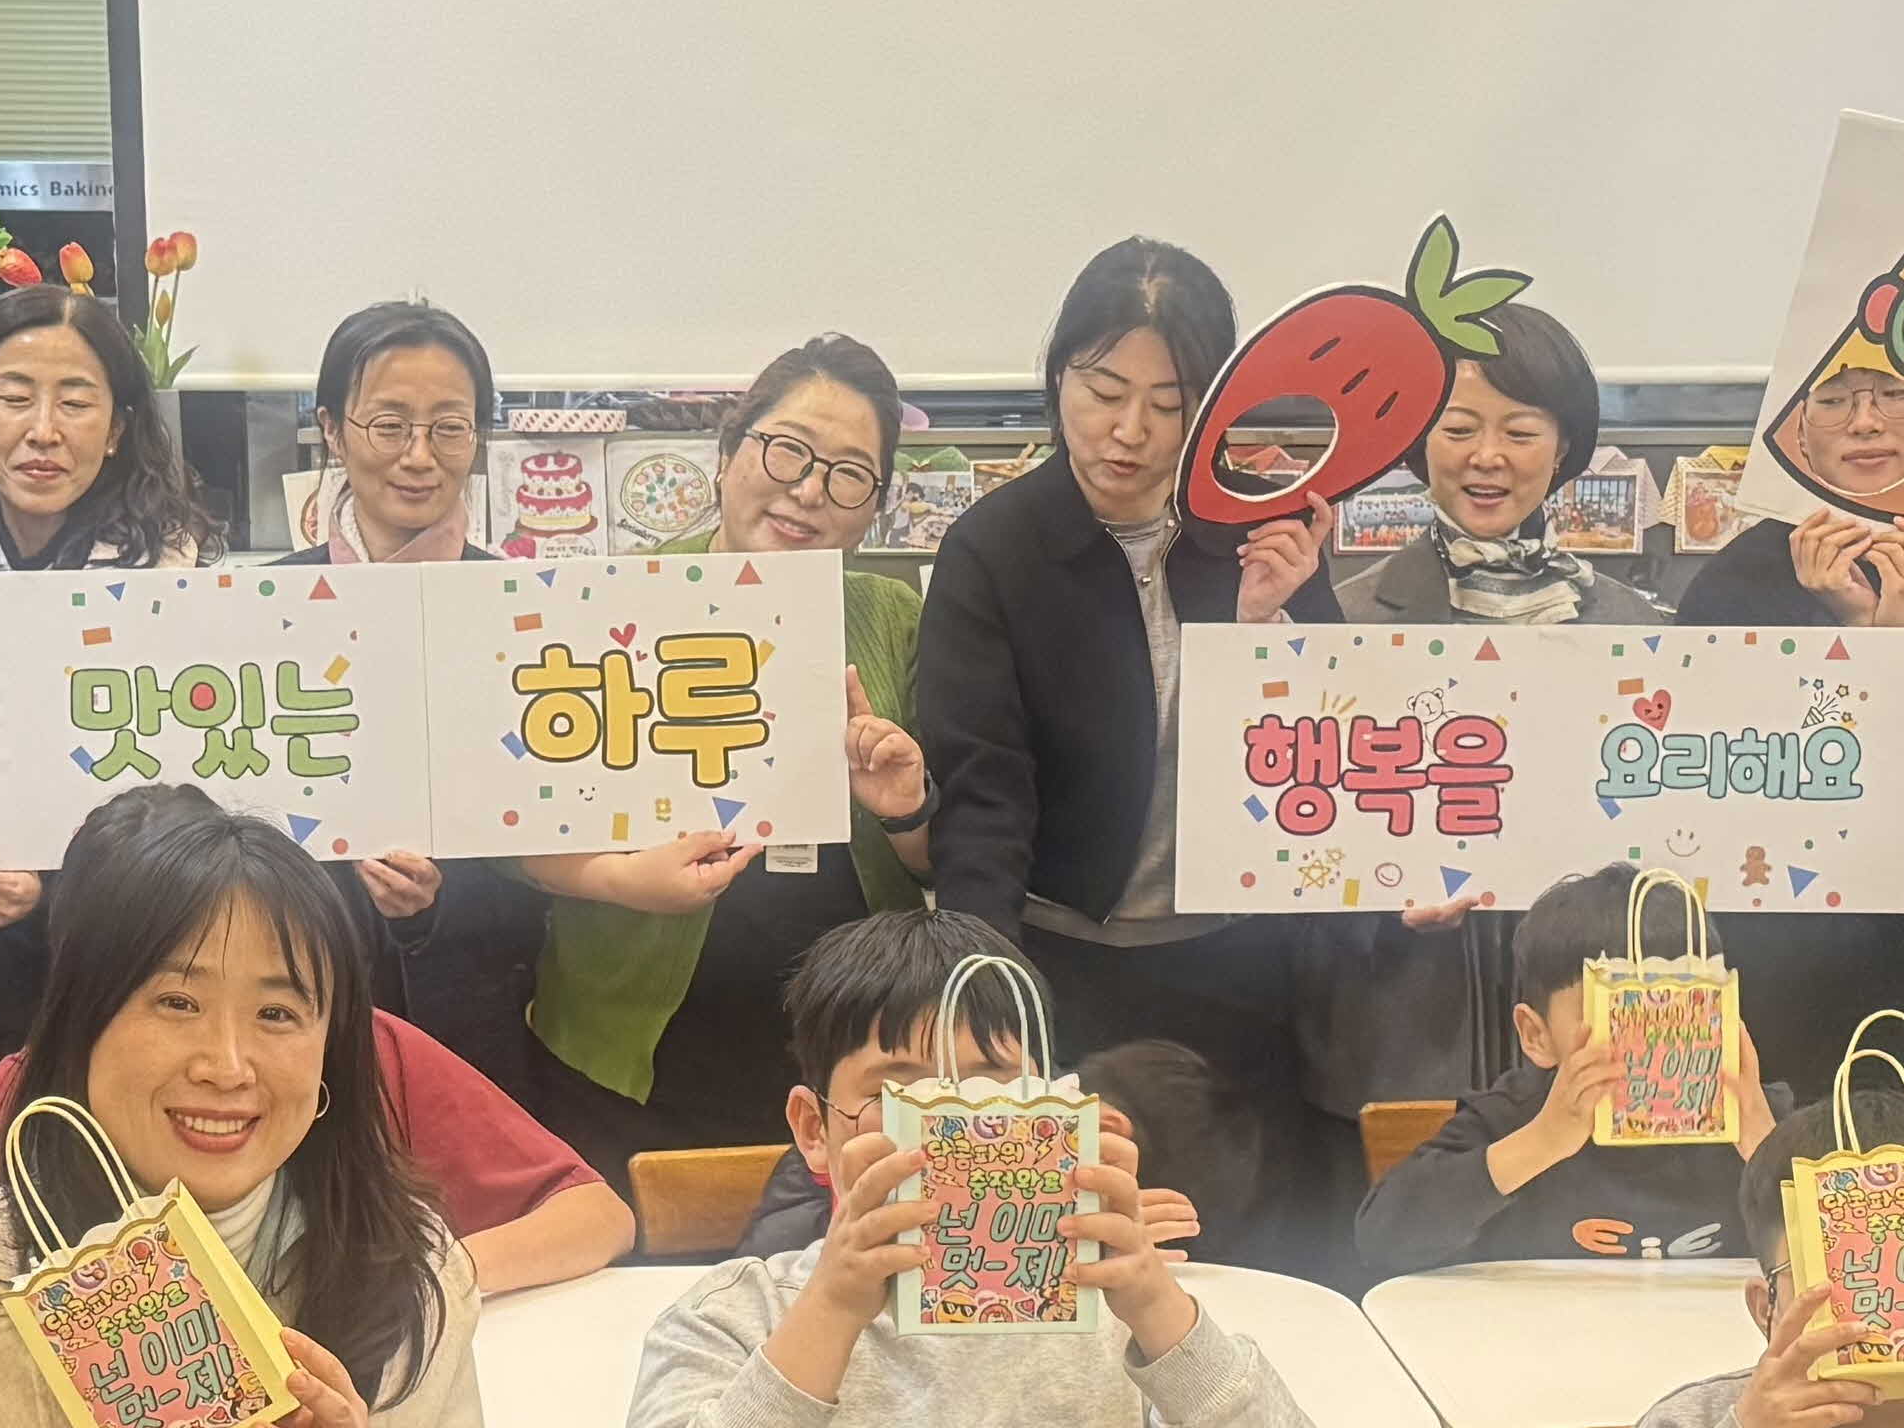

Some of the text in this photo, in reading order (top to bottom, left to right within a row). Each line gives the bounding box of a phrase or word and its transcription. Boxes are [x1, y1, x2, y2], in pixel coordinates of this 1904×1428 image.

[69, 660, 361, 782] 맛있는
[513, 631, 769, 787] 하루
[1245, 714, 1862, 836] 행복을 요리해요
[967, 1169, 1063, 1200] 충전완료
[937, 1201, 1076, 1245] 넌 이미
[1842, 1247, 1881, 1290] 넌
[44, 1276, 137, 1340] 달콤파워
[97, 1281, 189, 1348] 충전완료
[89, 1302, 220, 1405] 넌 이미
